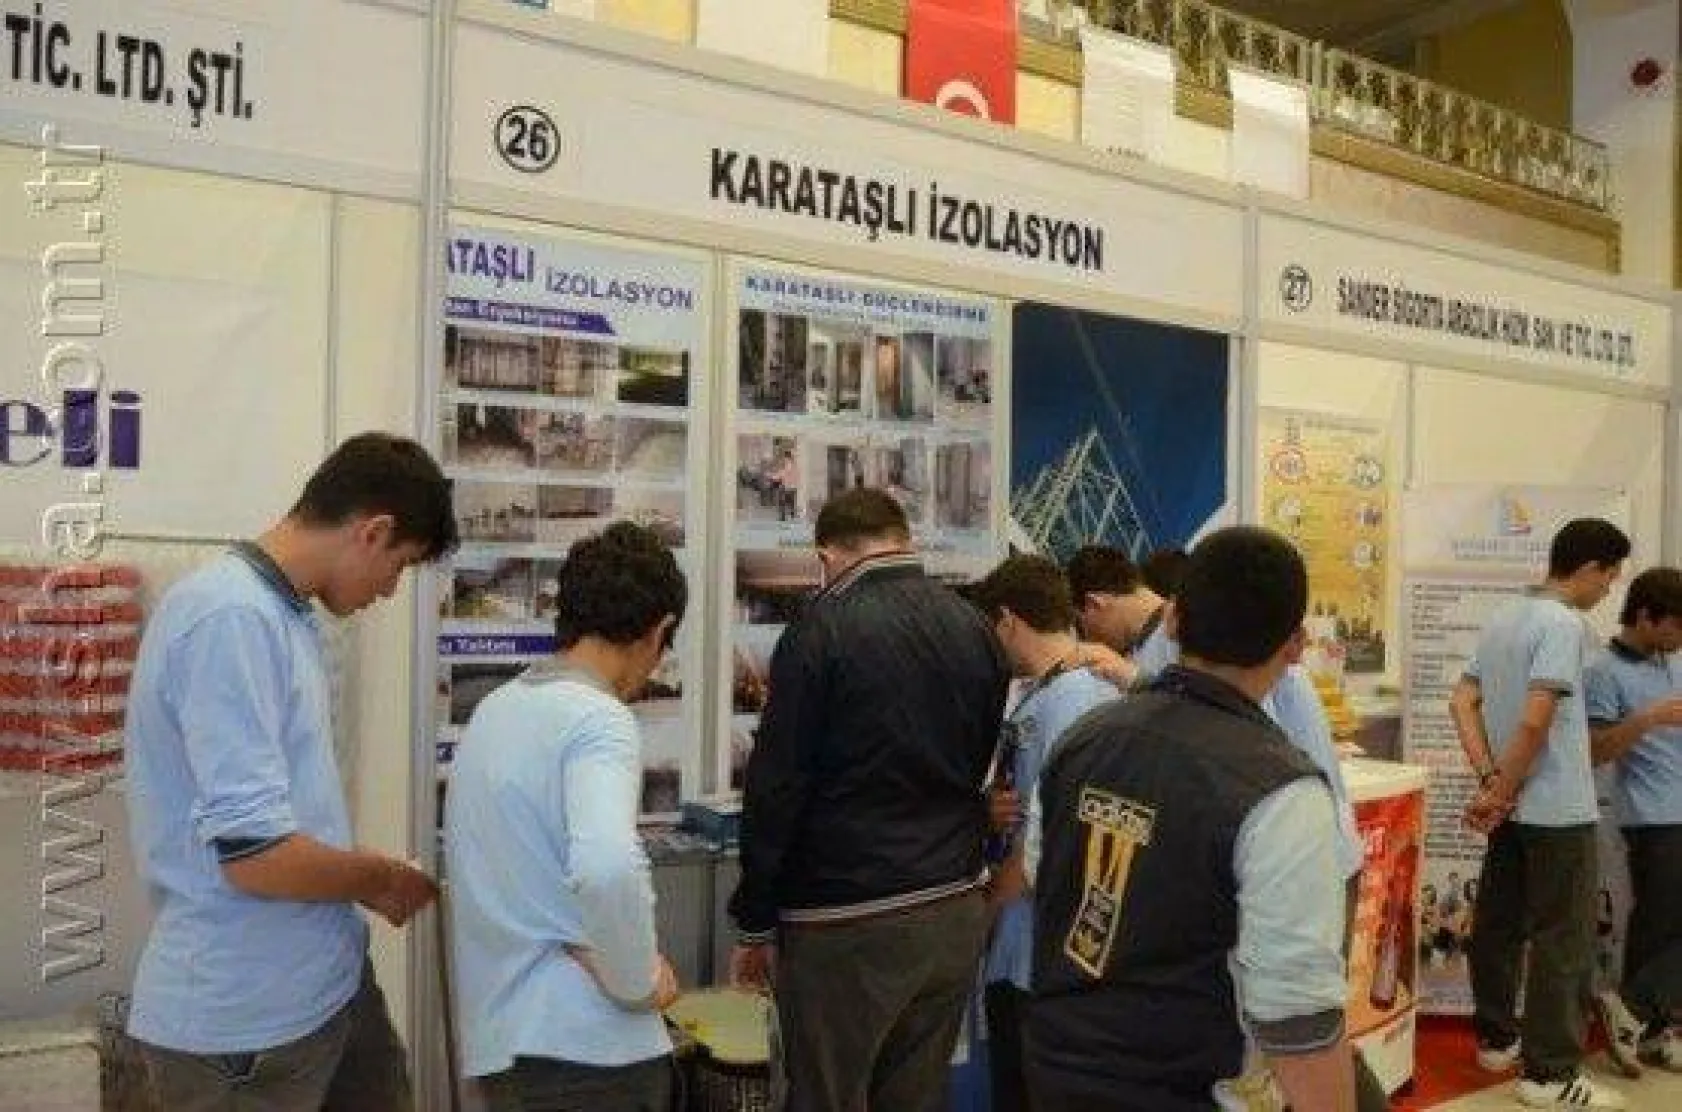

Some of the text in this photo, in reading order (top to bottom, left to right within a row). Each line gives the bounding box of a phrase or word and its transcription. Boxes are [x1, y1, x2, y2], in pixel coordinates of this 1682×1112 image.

[5, 3, 253, 128] TİC. LTD. ŞTİ.
[506, 114, 551, 162] 26
[711, 147, 1103, 271] KARATAŞLI İZOLASYON
